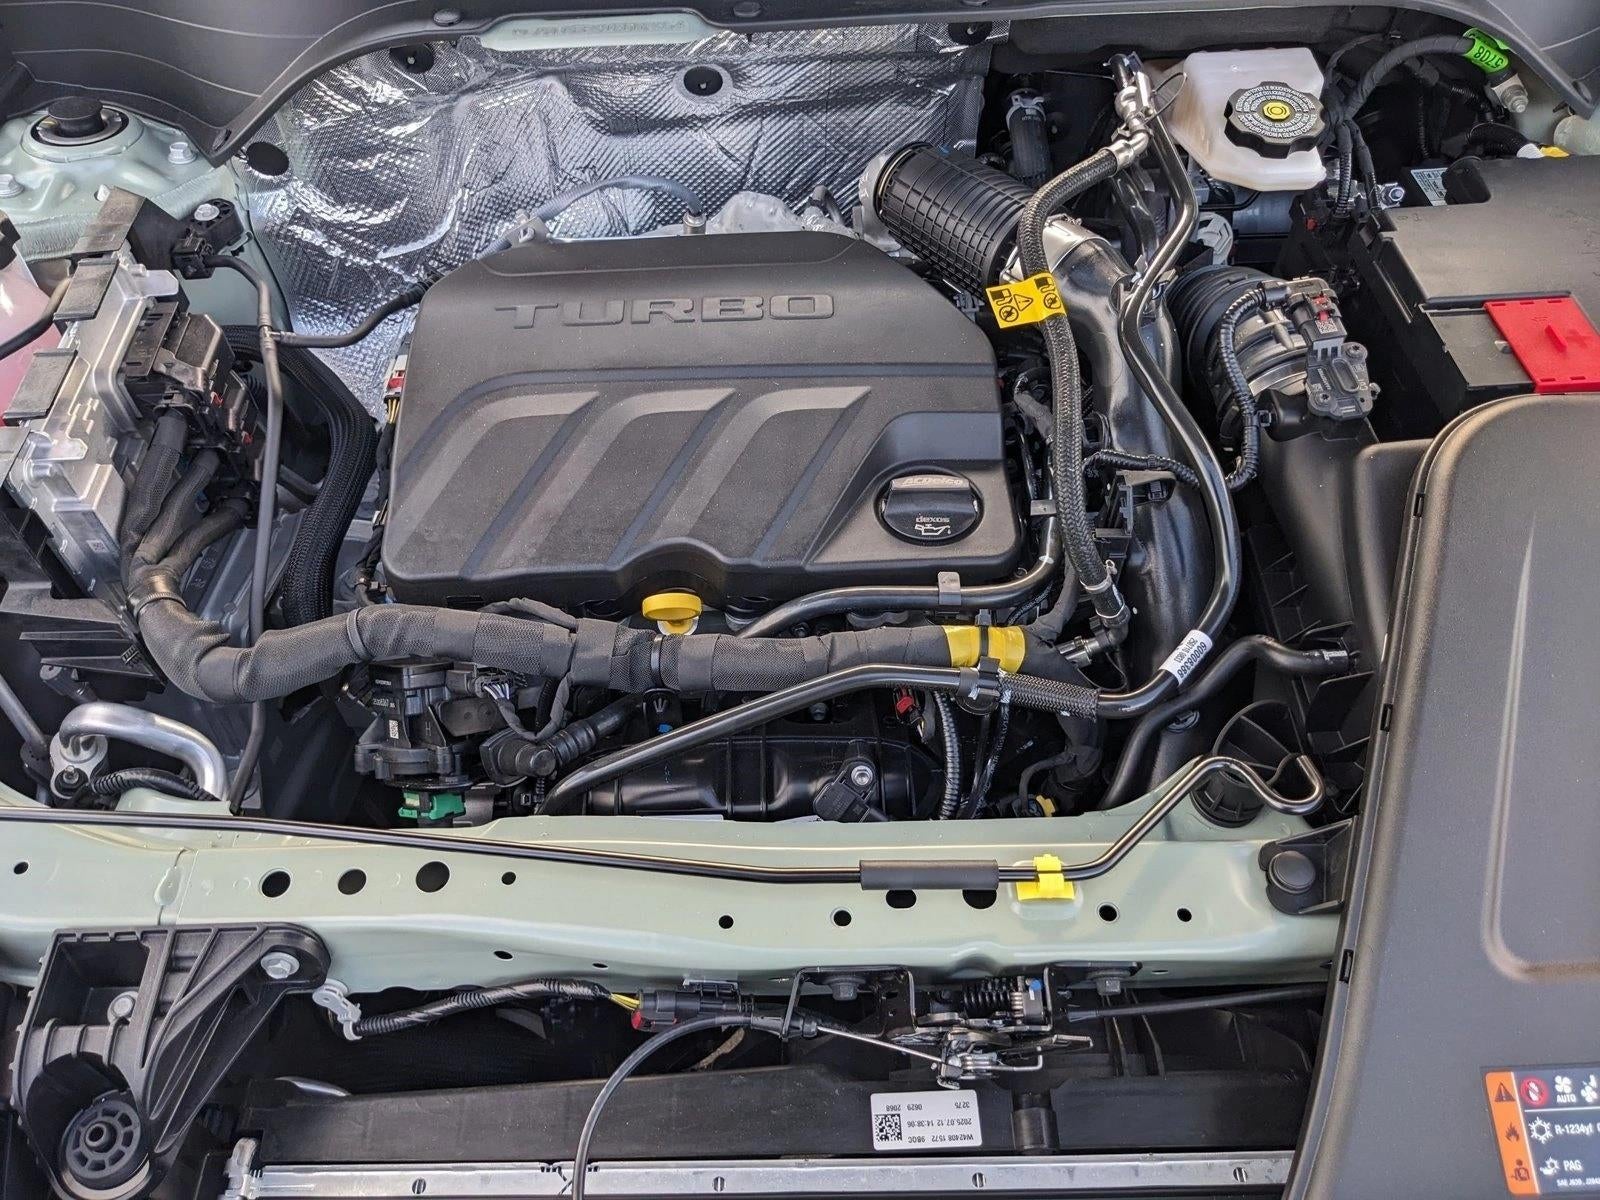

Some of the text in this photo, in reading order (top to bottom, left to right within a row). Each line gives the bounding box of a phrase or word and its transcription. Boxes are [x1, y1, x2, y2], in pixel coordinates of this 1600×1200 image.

[495, 294, 834, 329] TURBO
[915, 515, 950, 523] dexos
[1556, 1093, 1577, 1103] AUTO
[1554, 1122, 1593, 1136] R-1234yf
[1563, 1159, 1582, 1171] PAG
